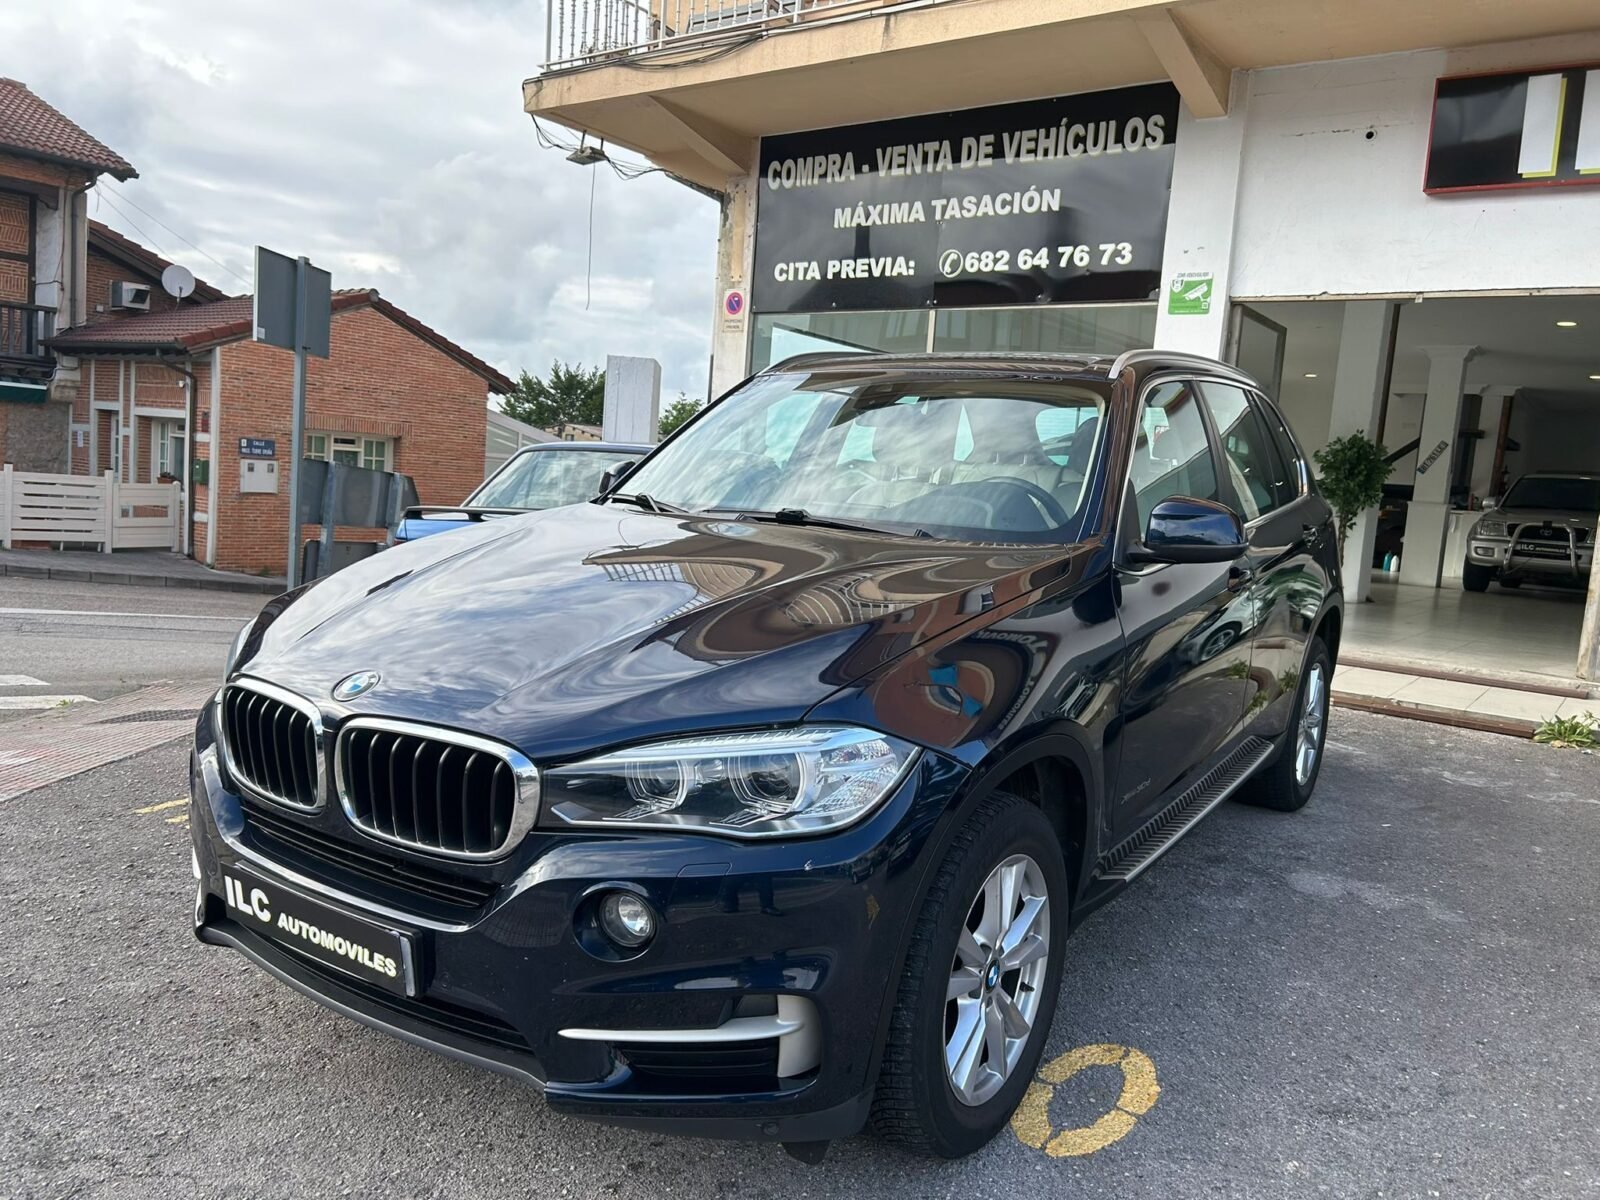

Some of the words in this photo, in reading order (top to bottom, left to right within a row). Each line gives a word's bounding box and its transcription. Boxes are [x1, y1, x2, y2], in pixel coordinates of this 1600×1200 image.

[767, 152, 855, 190] COMPRA
[876, 140, 953, 177] VENTA
[960, 134, 994, 169] DE
[1002, 114, 1165, 164] VEHÍCULOS
[833, 201, 925, 228] MÁXIMA
[931, 185, 1061, 221] TASACIÓN
[774, 261, 821, 282] CITA
[826, 255, 916, 279] PREVIA:
[965, 250, 1010, 273] 682
[1017, 247, 1049, 270] 64
[1057, 244, 1090, 268] 76
[1099, 242, 1132, 265] 73
[224, 875, 271, 923] ILC
[277, 912, 397, 978] AUTOMOVILES
